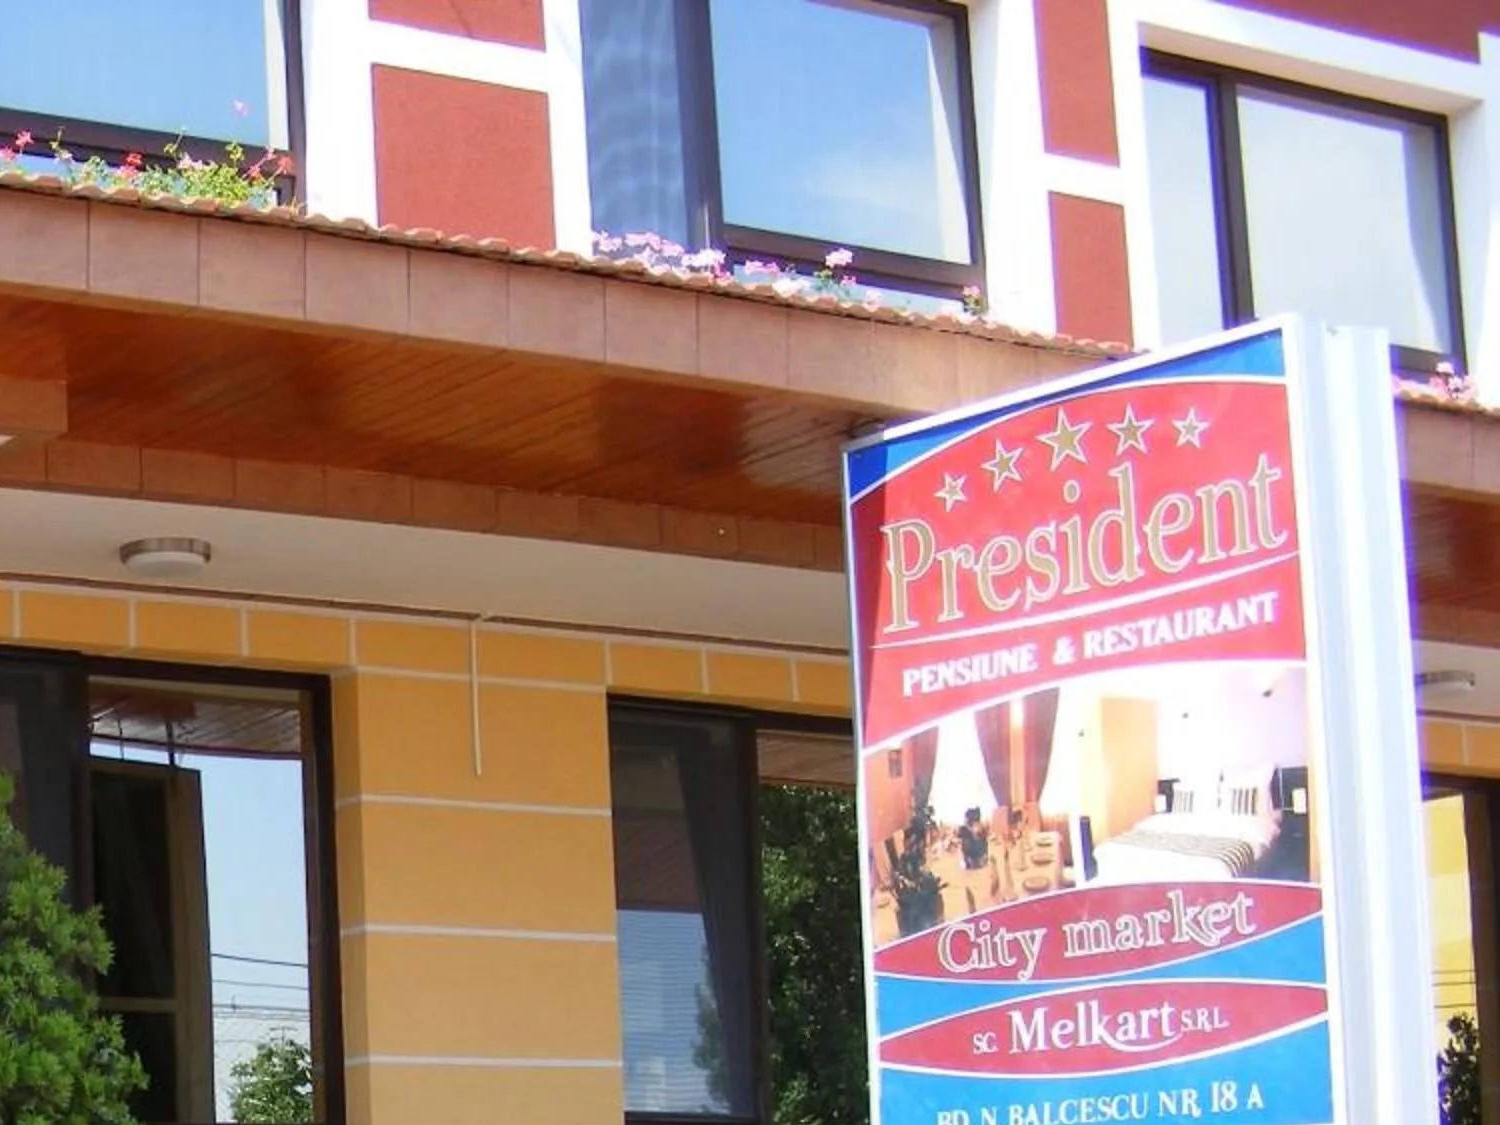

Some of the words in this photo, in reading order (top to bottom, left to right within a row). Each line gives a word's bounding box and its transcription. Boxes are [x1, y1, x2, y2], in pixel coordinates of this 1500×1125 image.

[882, 453, 1288, 634] President
[902, 643, 1039, 697] PENSIUNE
[1052, 636, 1077, 666] &
[1083, 591, 1279, 660] RESTAURANT
[937, 918, 1047, 982] City
[1063, 889, 1258, 958] market
[1008, 1000, 1182, 1054] Melkart
[1246, 1083, 1265, 1110] A
